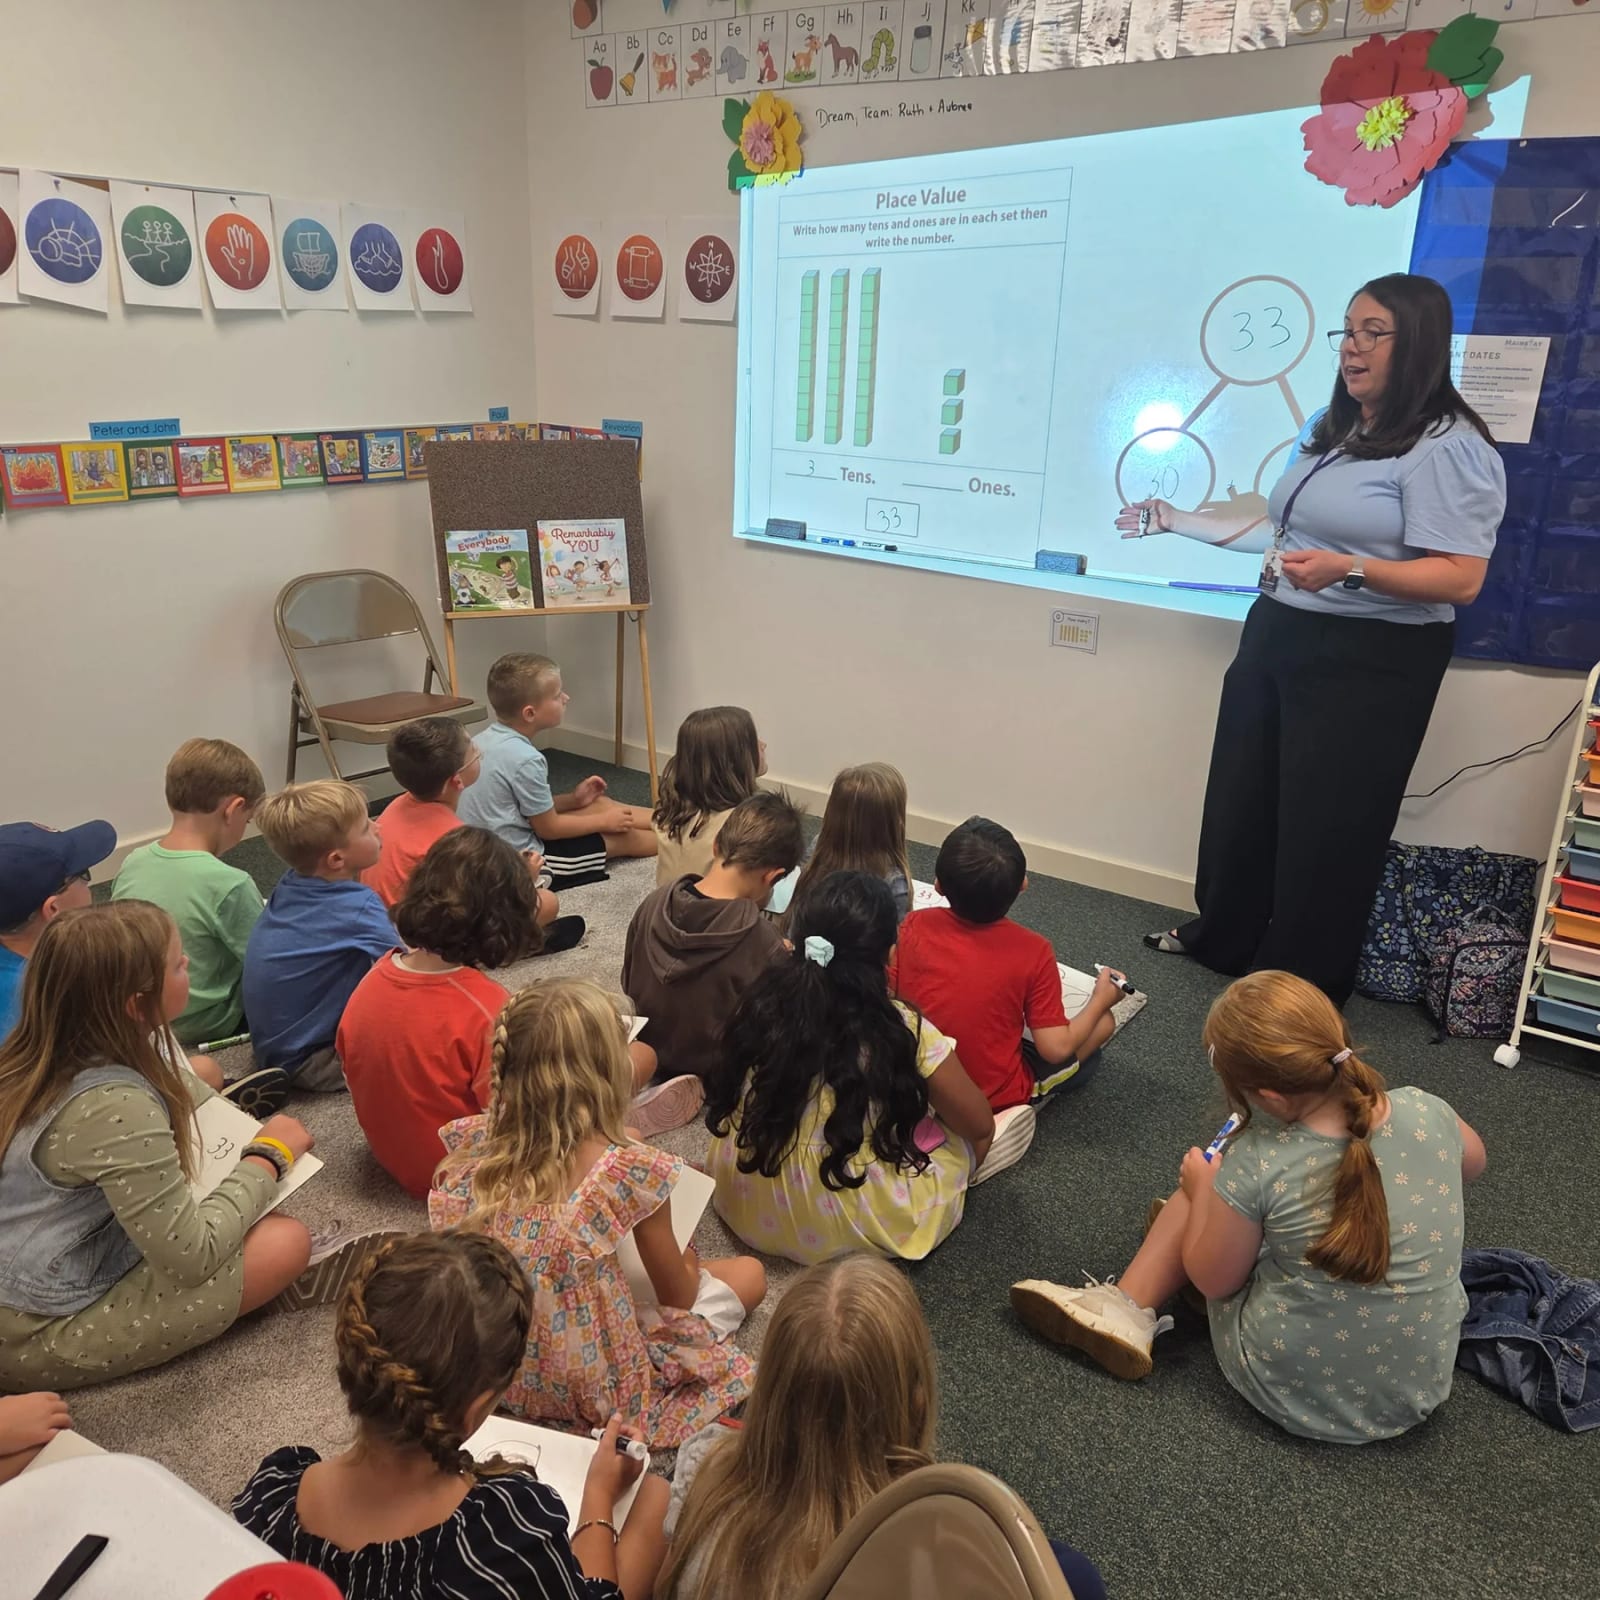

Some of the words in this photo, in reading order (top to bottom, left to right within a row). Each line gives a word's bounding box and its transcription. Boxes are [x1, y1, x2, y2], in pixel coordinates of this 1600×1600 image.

[593, 40, 607, 53] Aa
[626, 36, 640, 50] Bb
[658, 32, 674, 46] Cc
[692, 27, 708, 42] Dd
[727, 22, 742, 37] Ee
[763, 16, 775, 32] Ff
[795, 13, 815, 31] Gg
[837, 9, 853, 25] Hh
[879, 6, 888, 21] Ii
[921, 1, 931, 21] Jj
[961, 0, 975, 14] Kk
[898, 102, 925, 117] Ruth
[876, 190, 917, 210] Place
[921, 186, 967, 207] Value
[793, 225, 817, 237] Write
[819, 224, 838, 235] how
[840, 222, 866, 236] many
[868, 219, 889, 232] tens
[891, 217, 911, 230] and
[912, 216, 937, 229] ones
[939, 215, 957, 227] are
[959, 212, 969, 226] in
[971, 210, 998, 224] each
[1000, 208, 1018, 222] set
[1020, 206, 1048, 221] then
[708, 240, 714, 248] N
[865, 235, 891, 249] write
[892, 233, 909, 247] the
[911, 231, 955, 246] number.
[689, 262, 697, 271] W
[725, 265, 731, 276] E
[705, 289, 712, 298] S
[1232, 306, 1291, 352] 33
[1469, 351, 1501, 360] DATES
[92, 424, 124, 437] Peter
[127, 423, 150, 436] and
[153, 422, 178, 434] John
[603, 421, 641, 434] Revelation
[808, 459, 816, 477] 3
[840, 465, 876, 485] Tens.
[968, 476, 1016, 497] Ones.
[876, 506, 902, 533] 33
[457, 534, 510, 553] Everybody
[551, 527, 616, 544] Remarkably
[567, 539, 600, 553] YOU
[207, 1136, 235, 1160] 33
